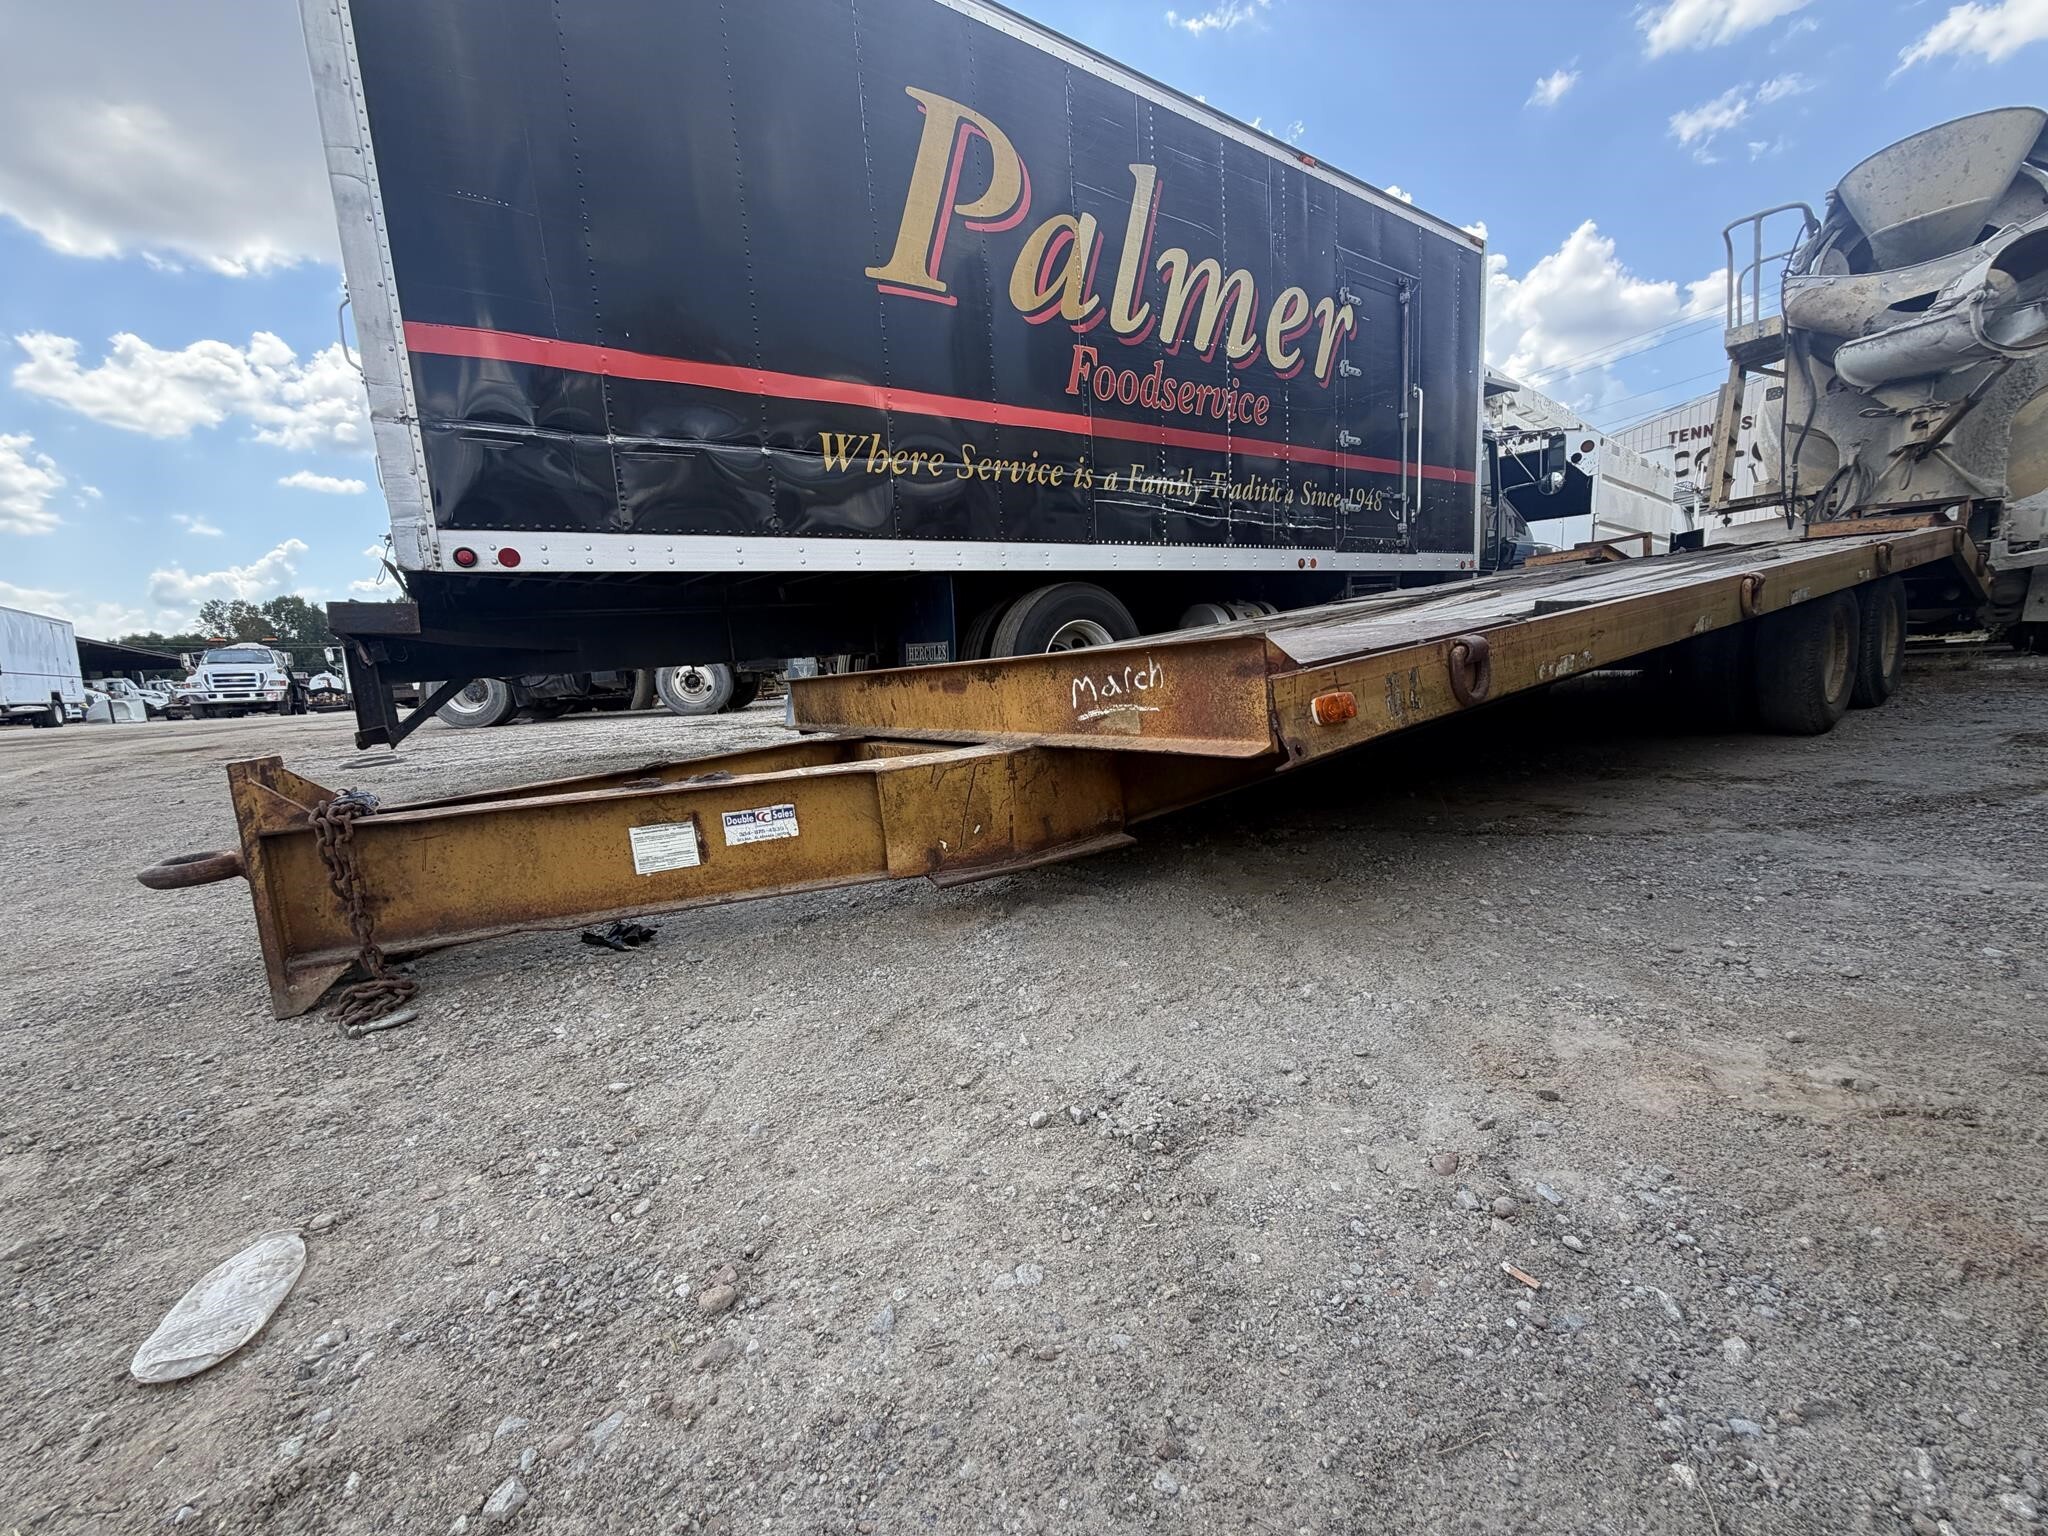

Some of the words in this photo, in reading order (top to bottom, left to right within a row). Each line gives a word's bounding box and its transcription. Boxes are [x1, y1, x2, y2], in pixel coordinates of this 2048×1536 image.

[865, 86, 1357, 387] Palmer
[1065, 344, 1270, 425] Foodservice
[818, 432, 945, 477] Where
[956, 443, 1064, 488] Service
[1073, 456, 1094, 489] is
[1103, 471, 1118, 490] a
[1126, 463, 1202, 506] Family
[1300, 480, 1341, 507] Since
[1348, 487, 1383, 511] 1948
[908, 644, 947, 662] HERCULES
[1072, 655, 1165, 709] March
[726, 813, 755, 826] Double
[772, 809, 794, 819] Sales
